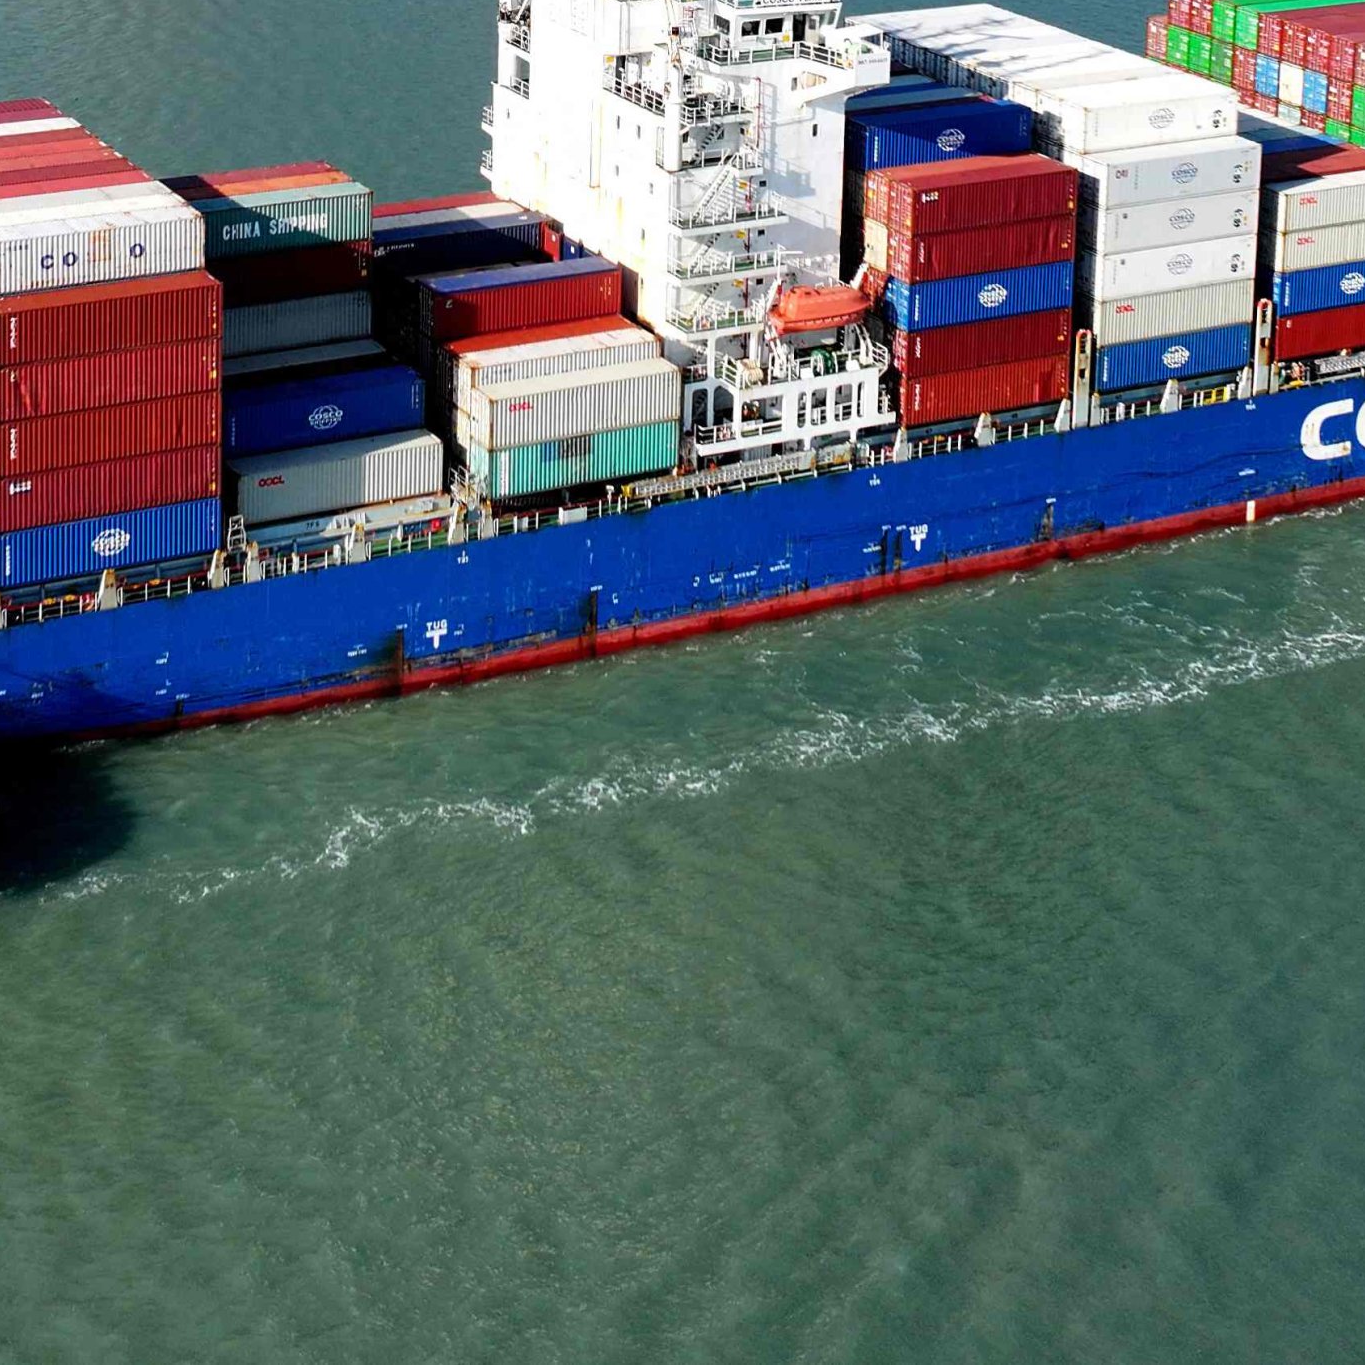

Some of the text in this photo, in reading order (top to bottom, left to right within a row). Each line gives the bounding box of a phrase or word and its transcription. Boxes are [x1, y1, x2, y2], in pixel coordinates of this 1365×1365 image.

[222, 212, 329, 241] CHINA SHIPPING
[308, 408, 344, 422] COSCO
[258, 474, 286, 488] OOCL
[909, 523, 929, 535] TUG
[426, 619, 447, 631] TUG
